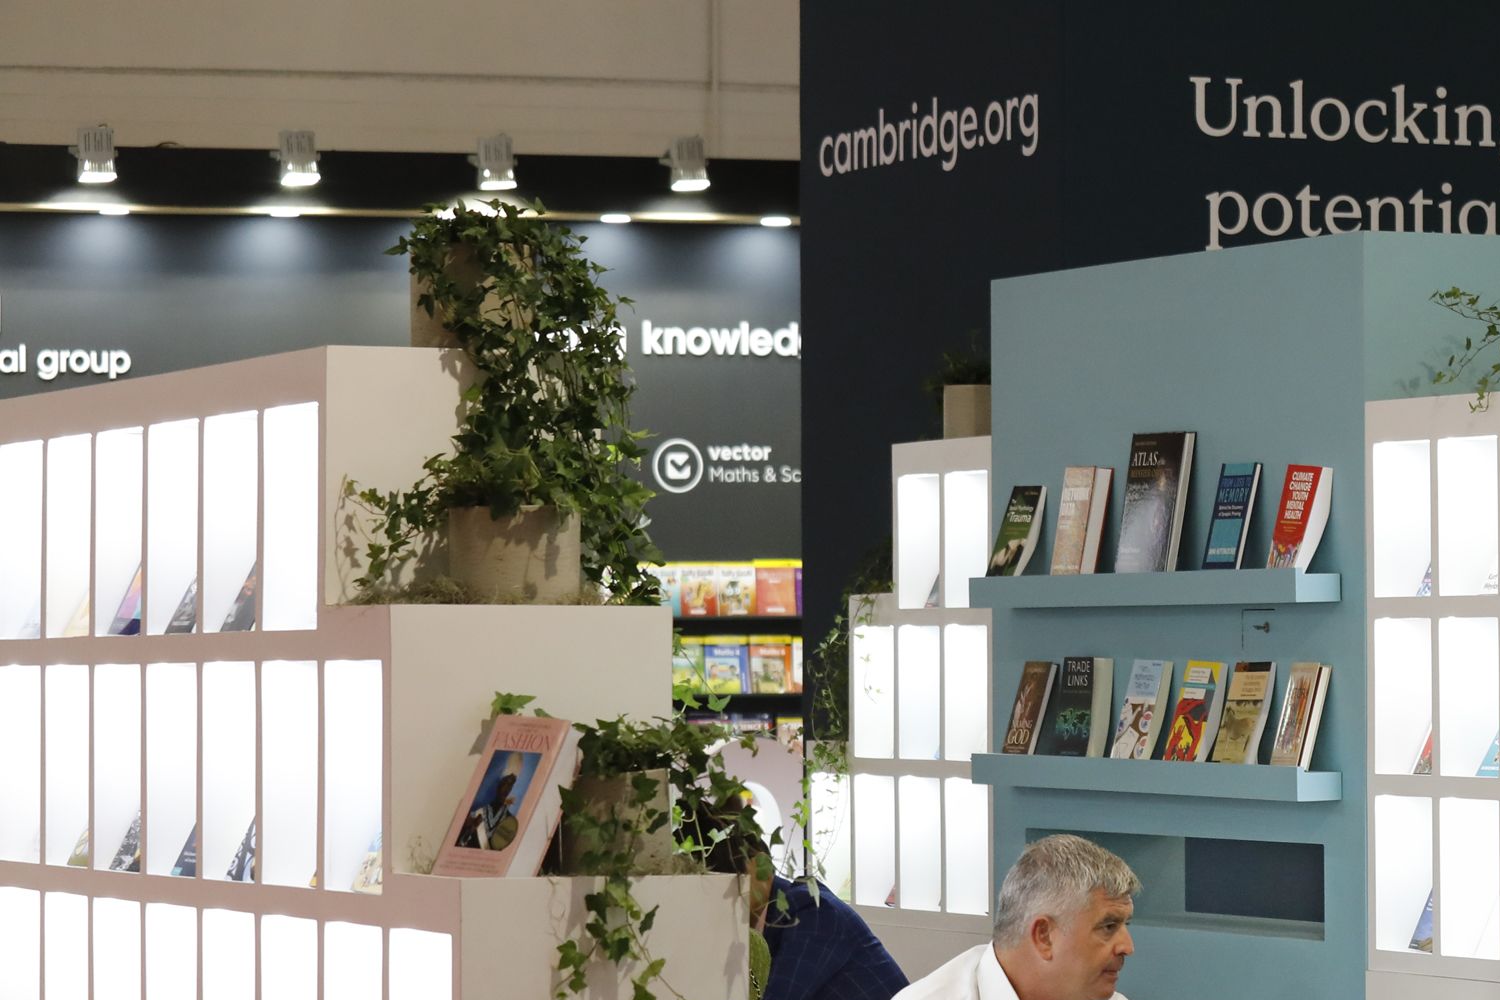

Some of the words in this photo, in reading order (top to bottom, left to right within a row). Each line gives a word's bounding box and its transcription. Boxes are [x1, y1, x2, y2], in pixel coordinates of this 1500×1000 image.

[819, 92, 1039, 178] cambridge.org
[36, 348, 132, 380] group
[707, 444, 772, 462] vector
[1132, 451, 1159, 467] ATLAS
[708, 466, 760, 484] Maths
[764, 467, 777, 483] &
[1291, 471, 1315, 482] CLIMATE
[1289, 481, 1312, 492] CHANGE
[1219, 487, 1250, 503] MEMORY
[1292, 491, 1309, 501] YOUTH
[1286, 500, 1305, 510] MENTAL
[1010, 511, 1032, 523] Trauma
[1284, 510, 1302, 520] HEALTH
[1067, 660, 1091, 673] TRADE
[1067, 674, 1088, 687] LINKS
[1007, 728, 1030, 745] GOD
